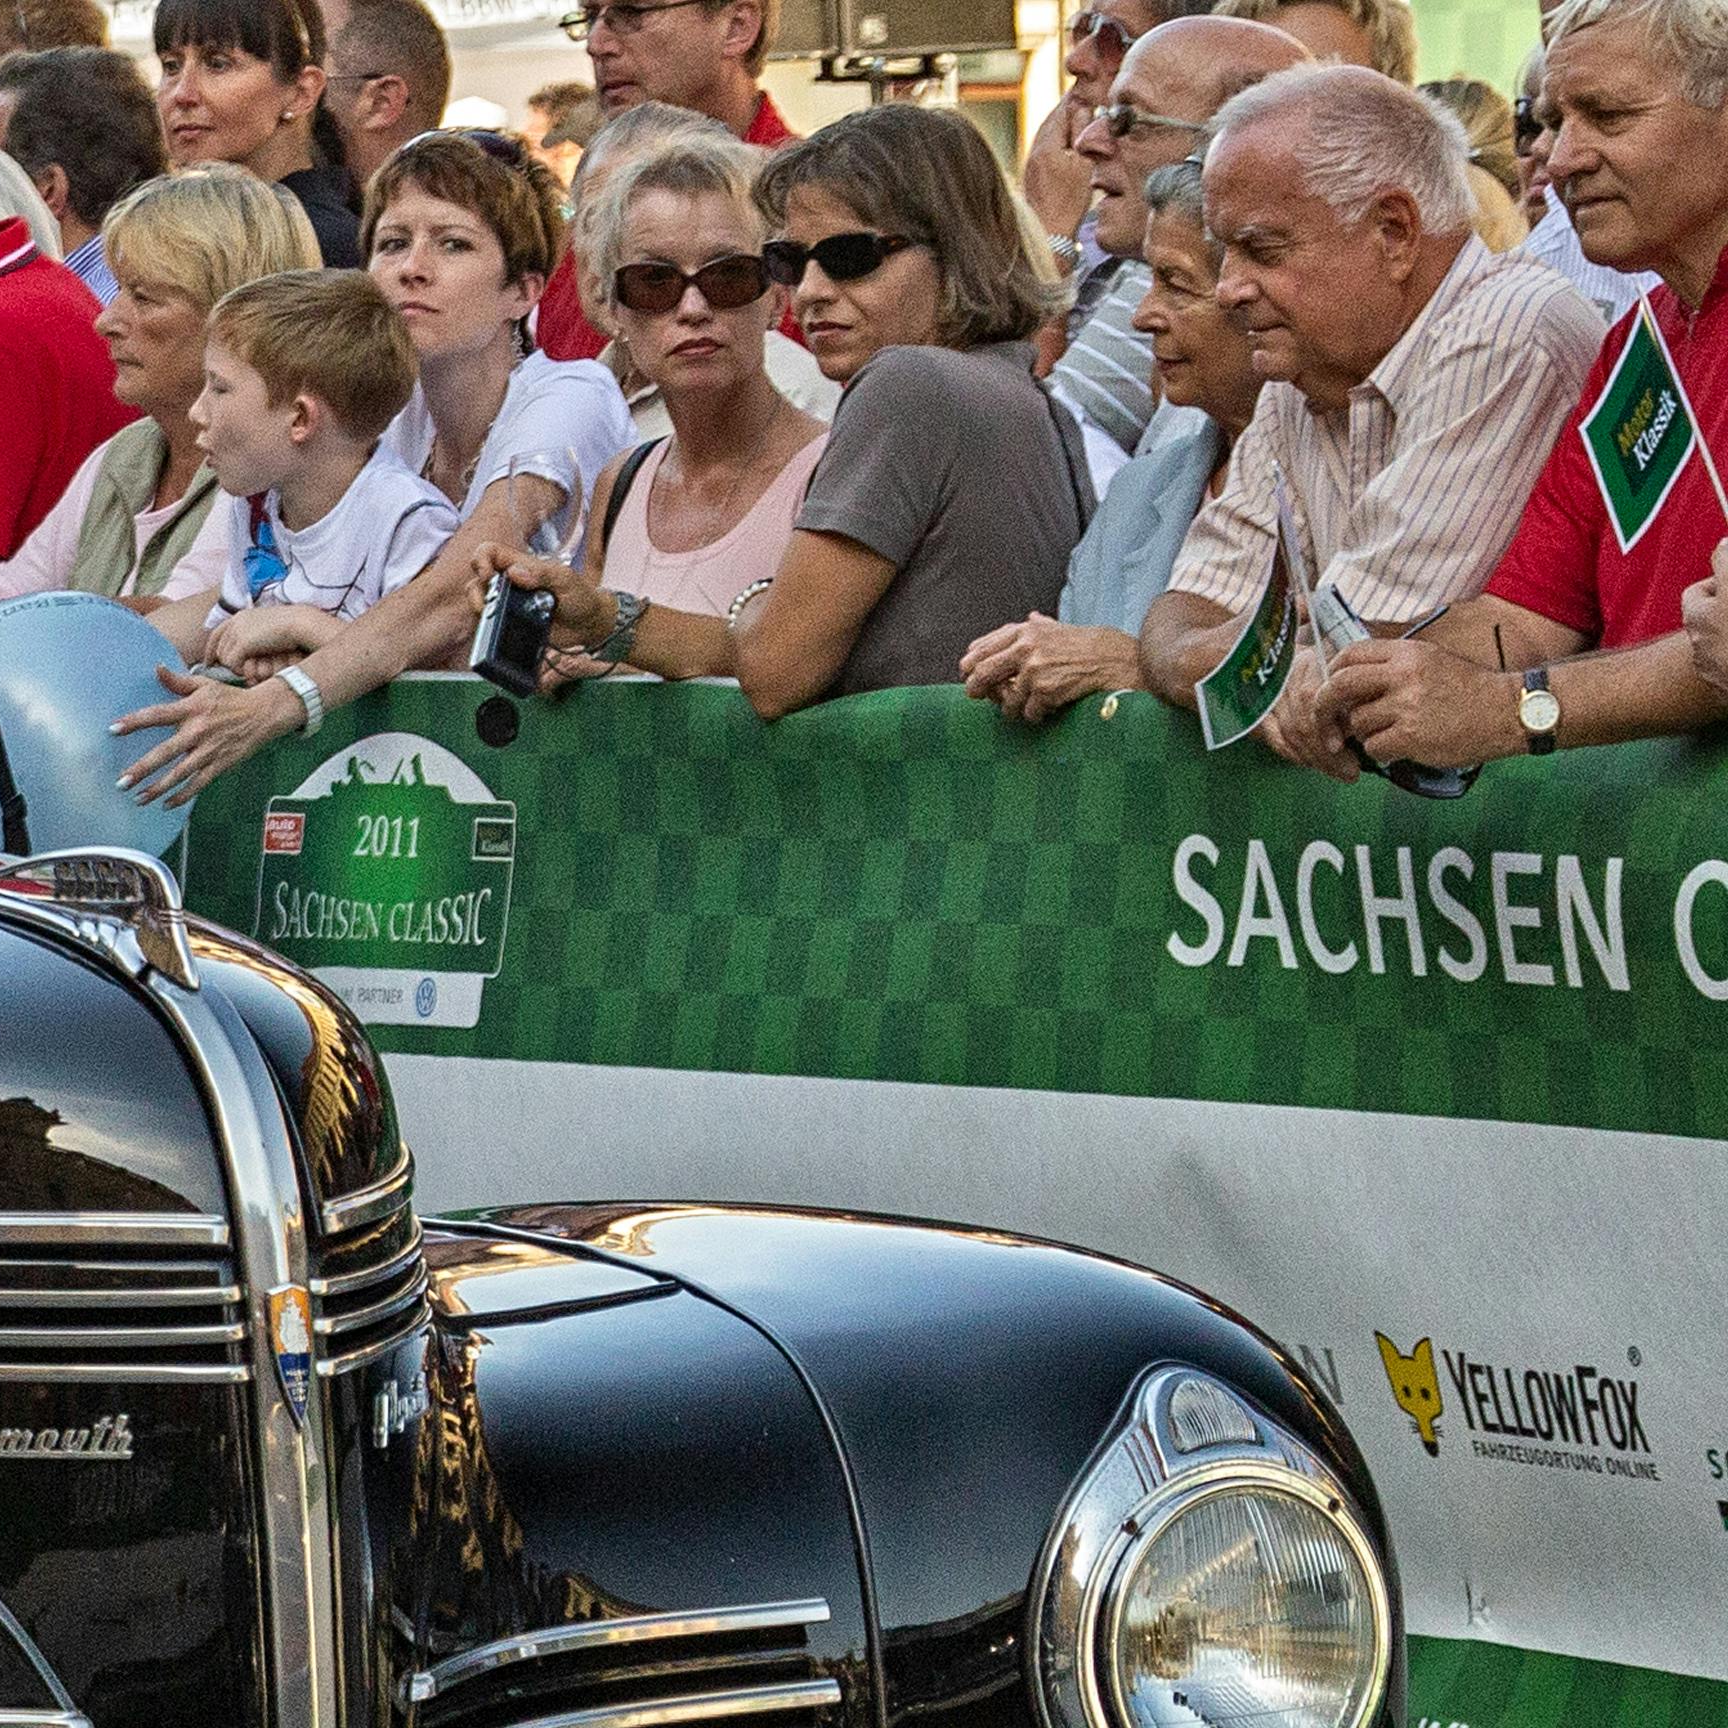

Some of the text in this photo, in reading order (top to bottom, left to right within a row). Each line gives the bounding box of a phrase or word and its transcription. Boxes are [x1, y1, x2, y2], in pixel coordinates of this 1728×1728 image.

[1632, 389, 1677, 470] Klassik
[353, 815, 420, 858] 2011
[272, 881, 492, 945] SACHSEN CLASSIC
[1167, 834, 1630, 991] SACHSEN
[358, 988, 403, 1005] PARTNER
[1473, 1440, 1662, 1482] FAHRZEUGORTUNG ONLINE
[1707, 1449, 1728, 1480] S
